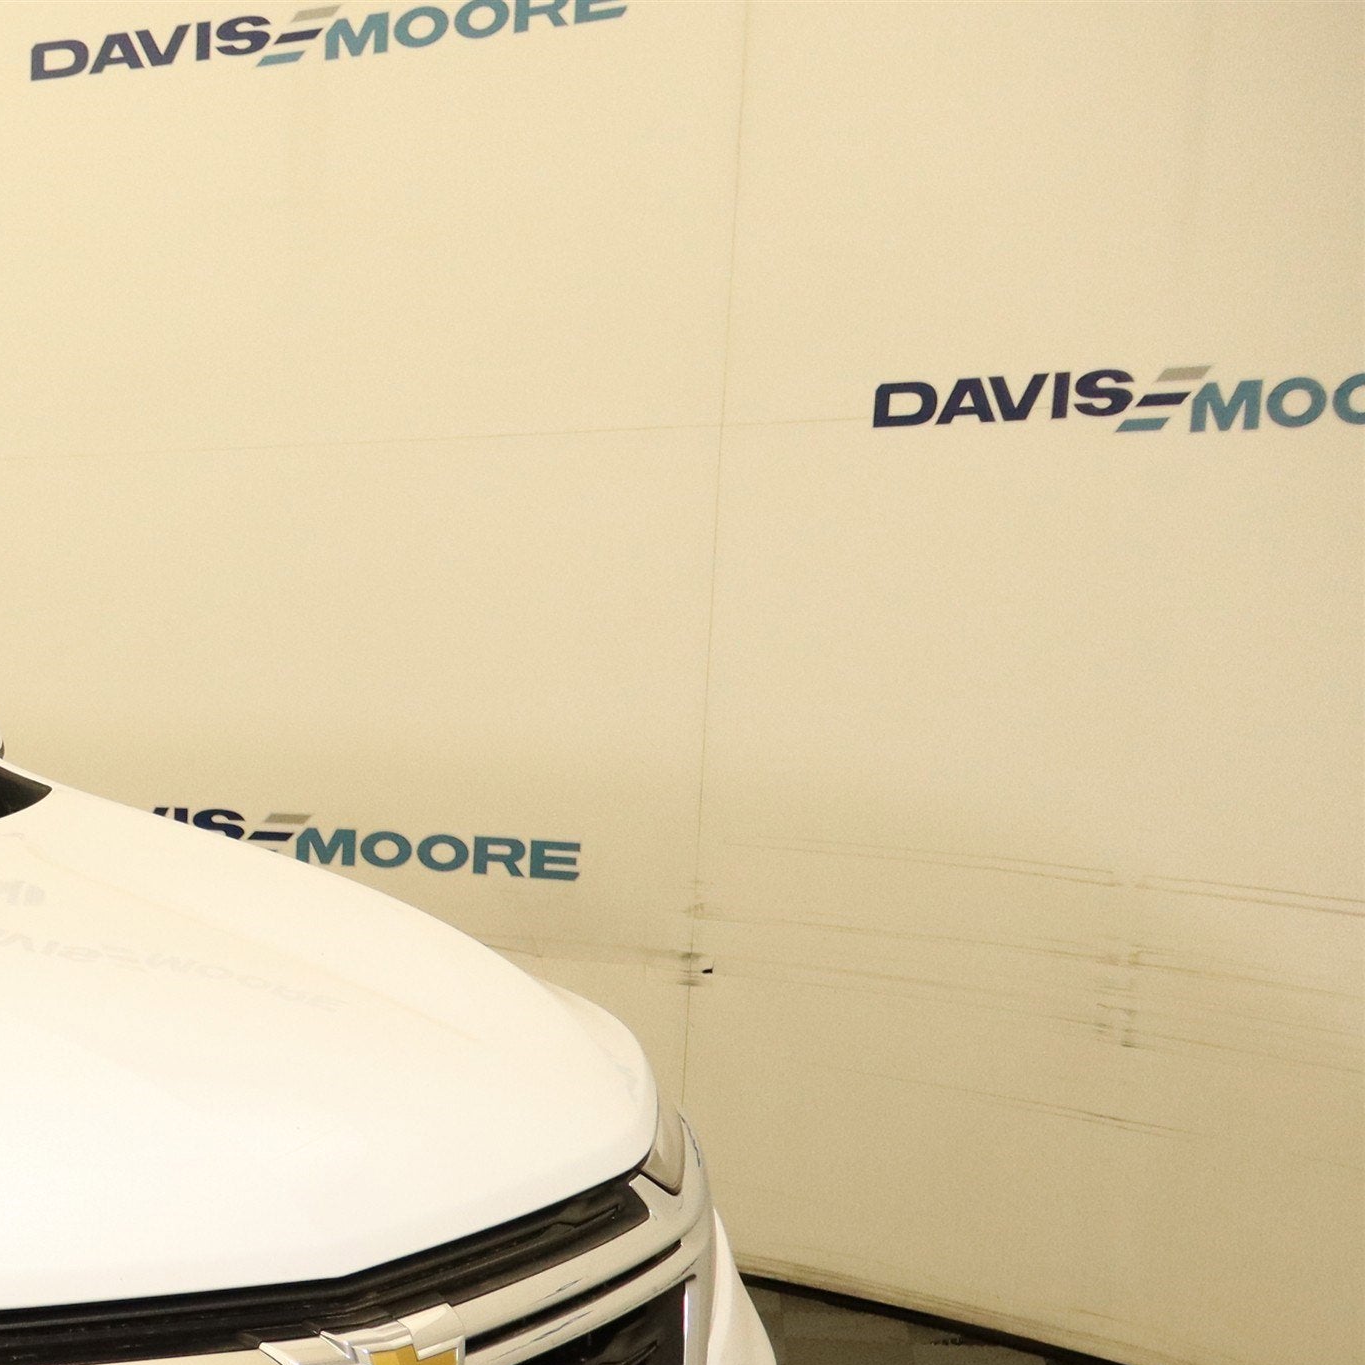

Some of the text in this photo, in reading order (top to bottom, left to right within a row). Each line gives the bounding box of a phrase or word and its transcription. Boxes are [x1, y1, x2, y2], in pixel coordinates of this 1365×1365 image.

[29, 14, 272, 81] DAVIS
[871, 368, 1136, 429] DAVIS
[296, 828, 582, 883] MOORE
